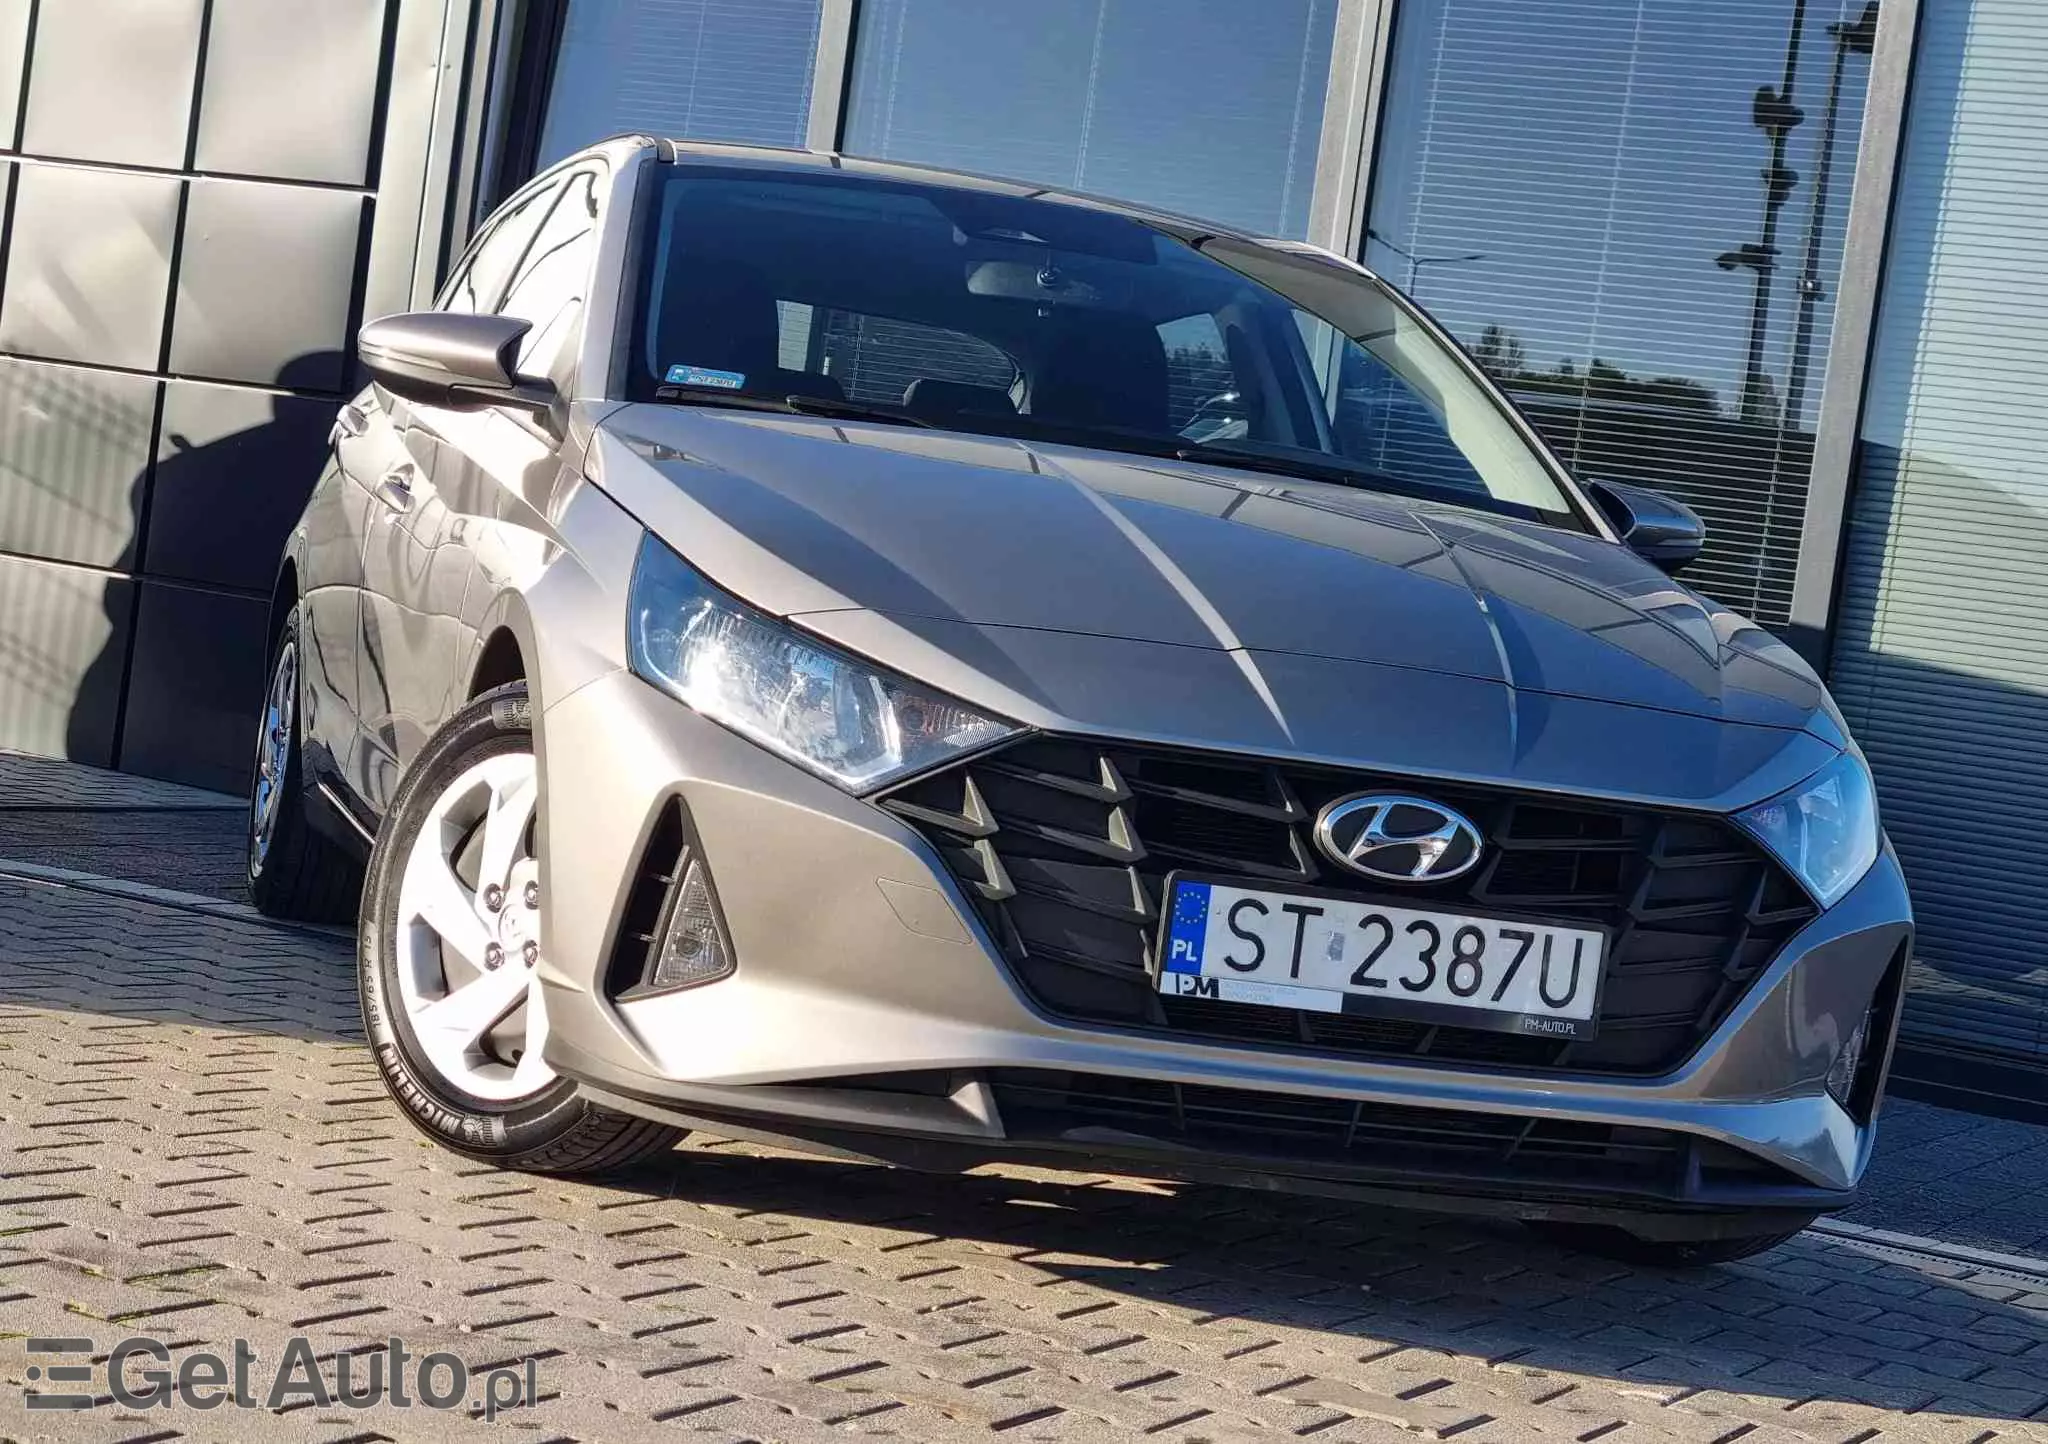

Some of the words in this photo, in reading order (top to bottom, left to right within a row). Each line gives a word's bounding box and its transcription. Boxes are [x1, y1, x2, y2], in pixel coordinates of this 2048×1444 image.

[363, 958, 373, 969] R
[1172, 939, 1198, 962] PL
[1224, 898, 1324, 979] ST
[1350, 914, 1583, 1009] 2387U
[366, 975, 381, 1029] 185/65
[1524, 1018, 1577, 1035] PM-AUTO.PL
[379, 1046, 461, 1135] MICHELIN
